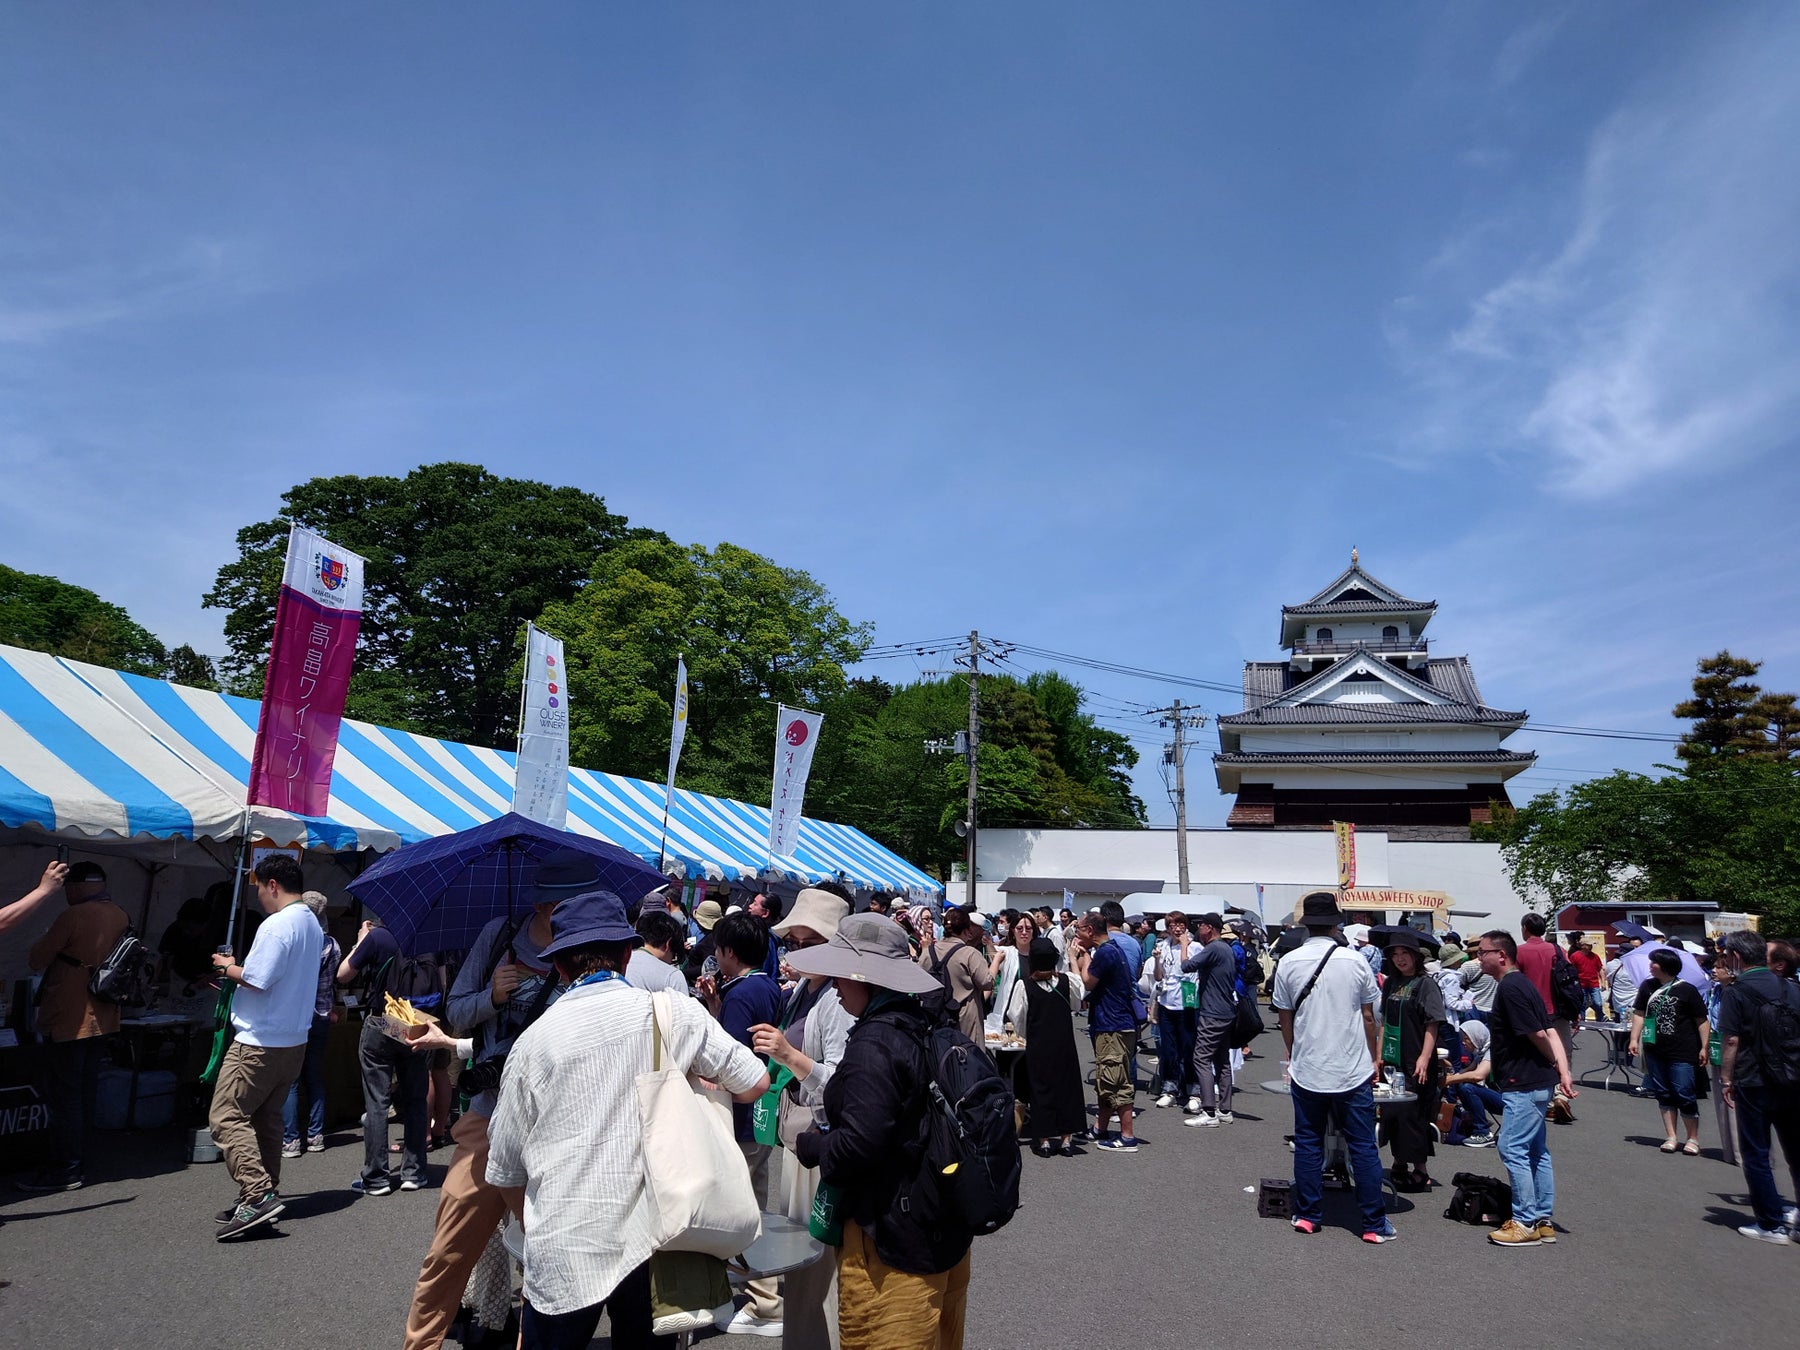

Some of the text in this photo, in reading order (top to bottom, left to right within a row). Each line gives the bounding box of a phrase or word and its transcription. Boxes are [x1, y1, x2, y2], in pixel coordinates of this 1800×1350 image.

[287, 621, 334, 806] 高畠ワイナリー
[540, 708, 566, 722] OUSE
[540, 718, 566, 730] WINERY
[1379, 891, 1414, 904] SWEETS
[1417, 895, 1444, 909] SHOP
